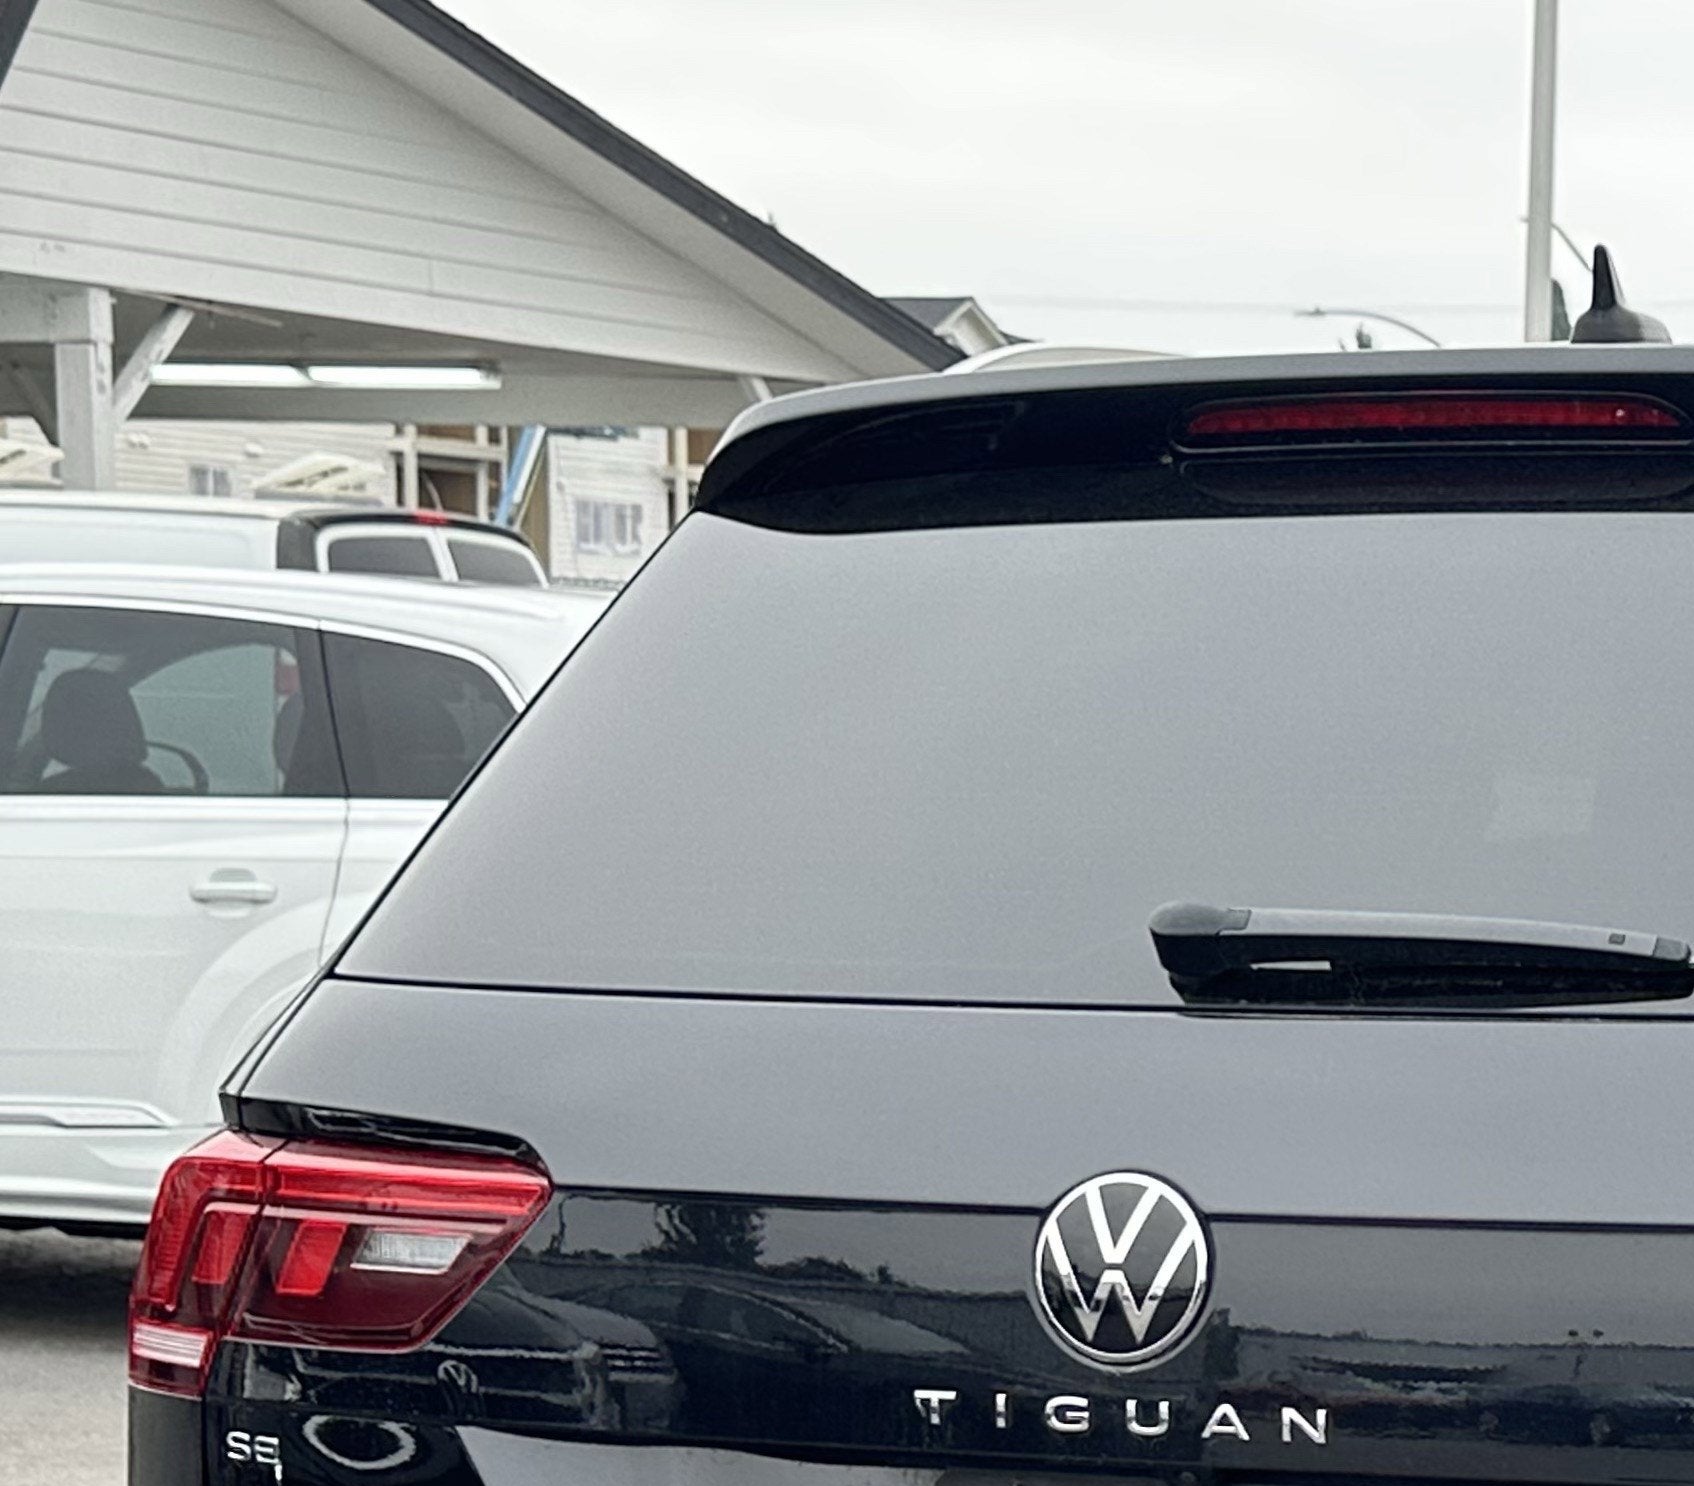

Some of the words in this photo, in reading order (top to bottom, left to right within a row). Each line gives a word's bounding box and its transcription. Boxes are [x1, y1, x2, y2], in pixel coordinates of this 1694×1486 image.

[1042, 1177, 1200, 1348] VW
[913, 1389, 1327, 1444] TIGUAN
[226, 1431, 280, 1465] SE
